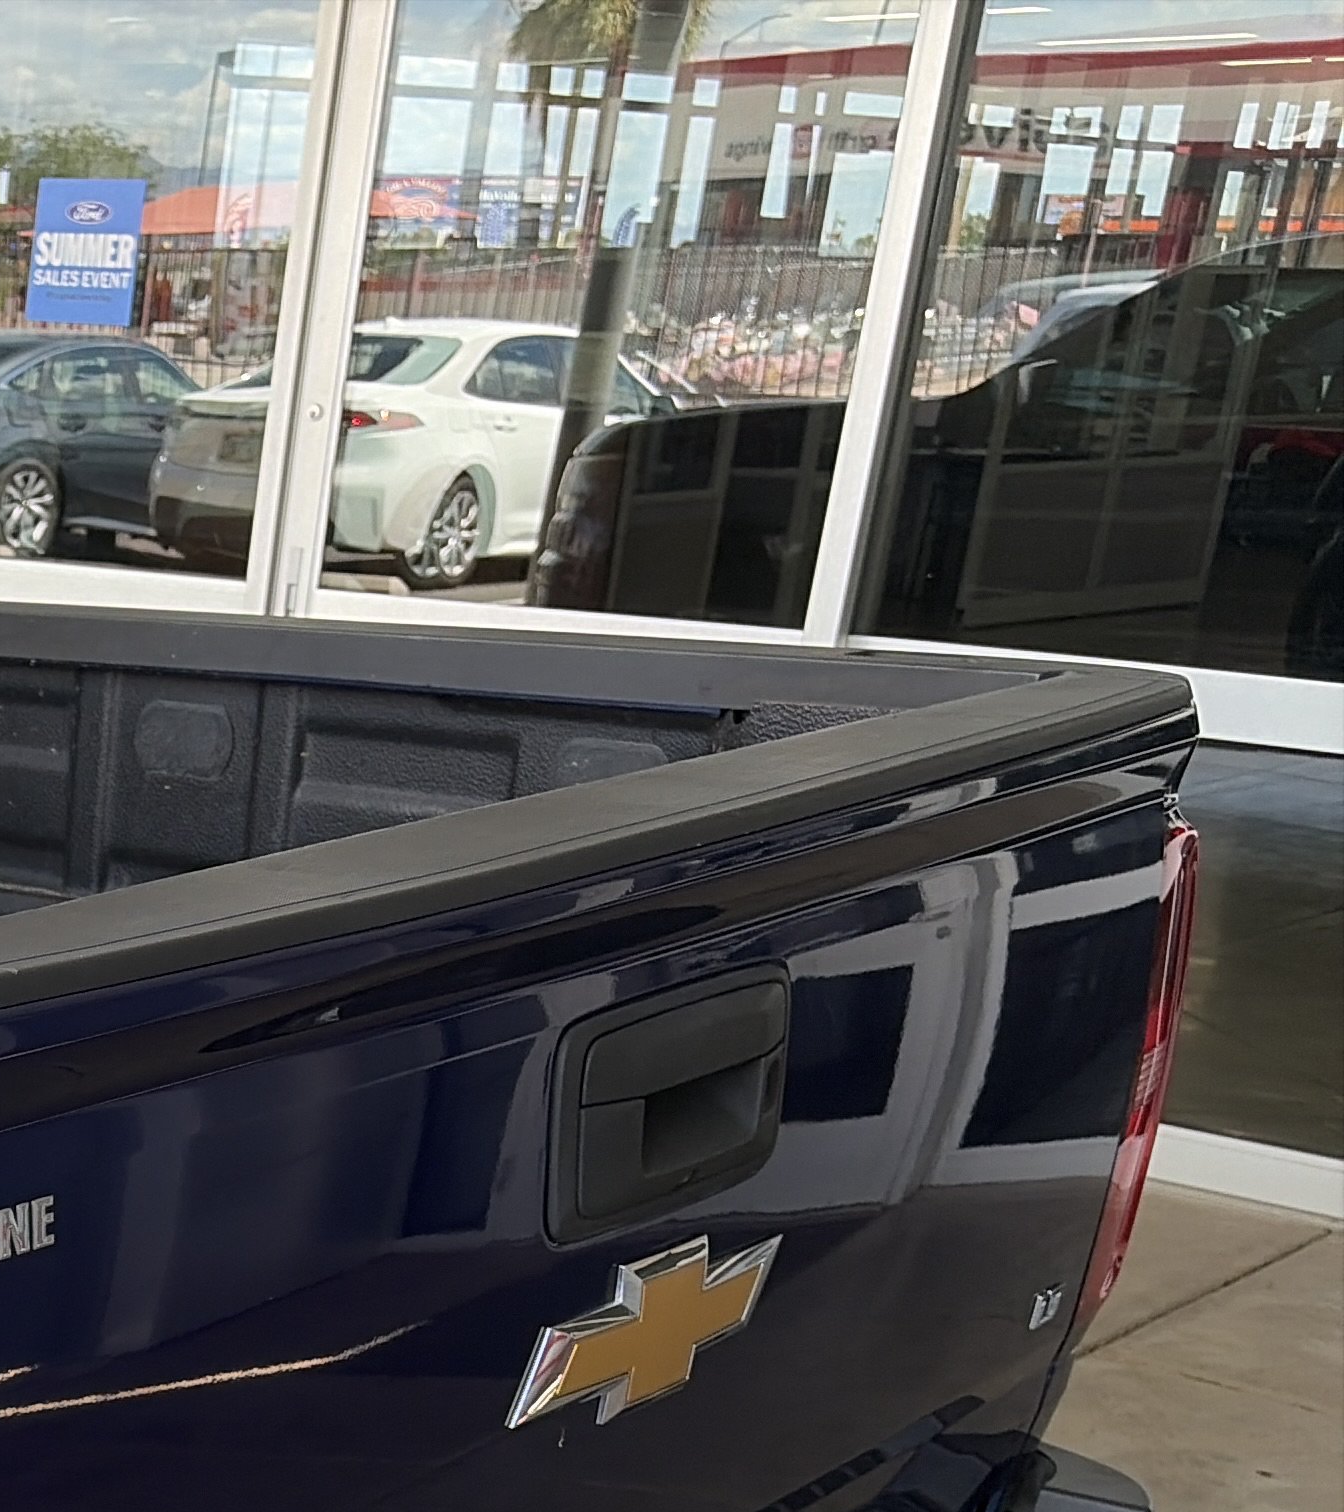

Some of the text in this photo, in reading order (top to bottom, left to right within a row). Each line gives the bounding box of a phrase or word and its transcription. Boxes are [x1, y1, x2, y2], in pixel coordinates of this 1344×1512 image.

[69, 203, 110, 222] Ford
[34, 232, 134, 269] SUMMER
[32, 268, 132, 289] SALES EVENT
